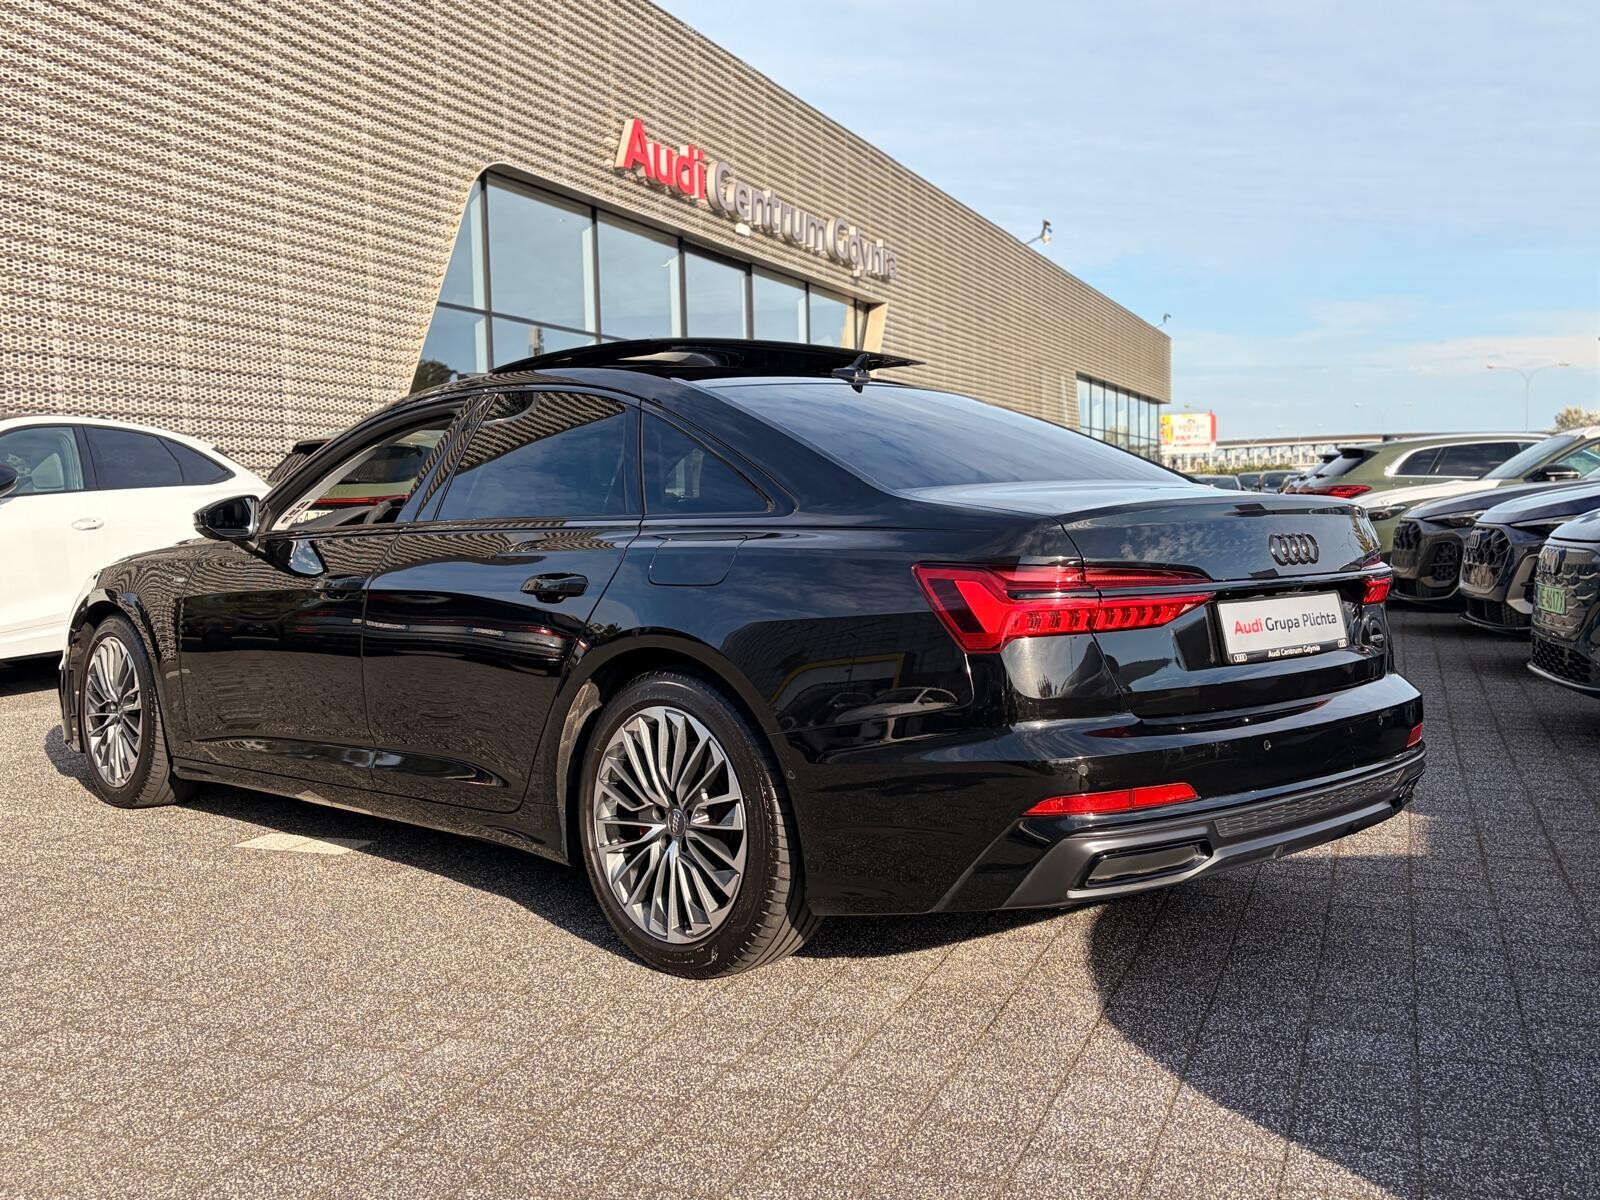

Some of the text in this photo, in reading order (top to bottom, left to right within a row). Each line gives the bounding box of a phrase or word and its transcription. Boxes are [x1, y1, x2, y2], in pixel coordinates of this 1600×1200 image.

[615, 117, 898, 280] Audi Centrum Gdynia
[1234, 612, 1337, 635] Audi Grupa Plichta
[1268, 644, 1321, 658] Audi Centrum Gdynia
